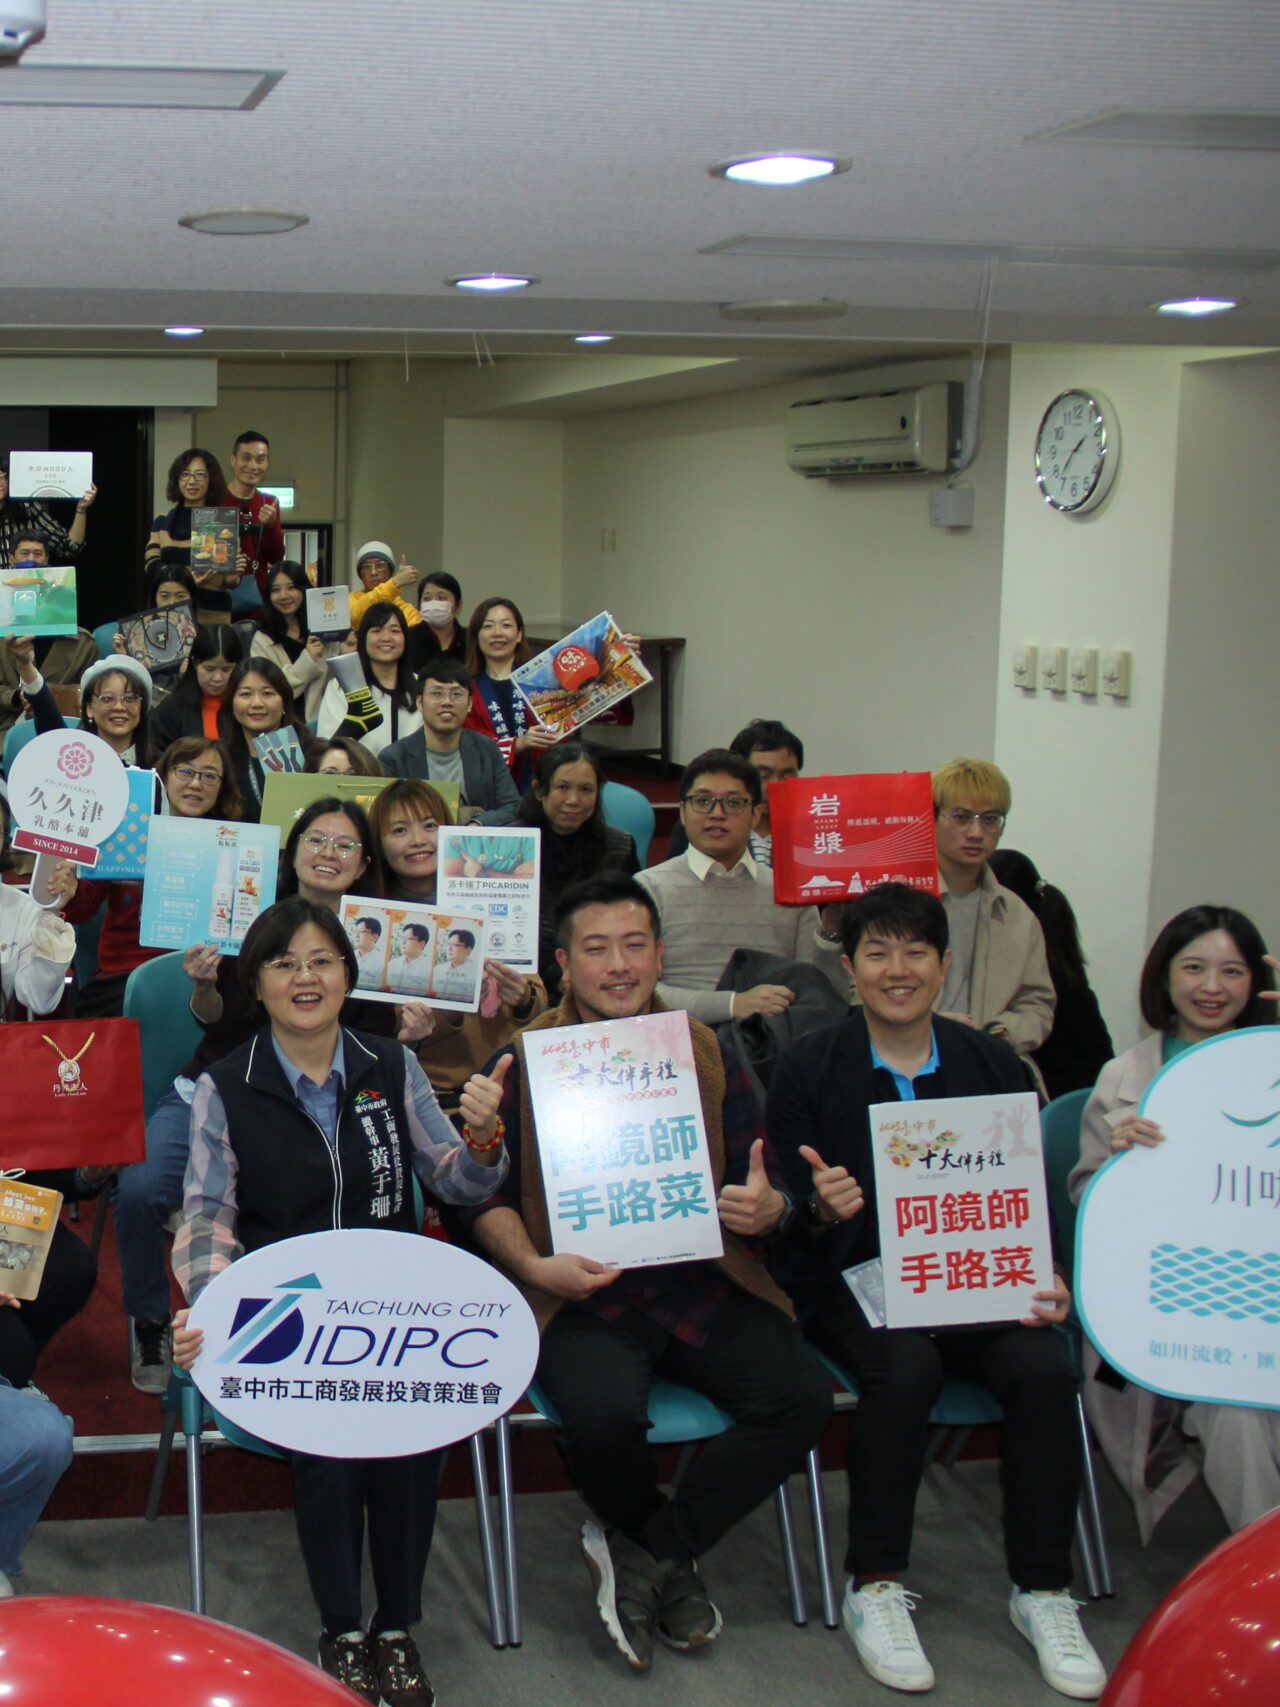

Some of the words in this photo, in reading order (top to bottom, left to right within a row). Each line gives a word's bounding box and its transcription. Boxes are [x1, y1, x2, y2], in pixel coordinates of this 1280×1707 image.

[26, 786, 104, 823] 久久津
[808, 793, 841, 817] 岩
[33, 837, 58, 850] SINCE
[59, 844, 79, 856] 2014
[814, 831, 846, 855] 漿
[556, 1171, 710, 1232] 手路菜
[895, 1187, 1030, 1237] 阿鏡師
[900, 1245, 1037, 1294] 手路菜
[325, 1300, 453, 1318] TAICHUNG
[459, 1302, 512, 1319] CITY
[220, 1376, 504, 1405] 臺中市工商發展投資策進會
